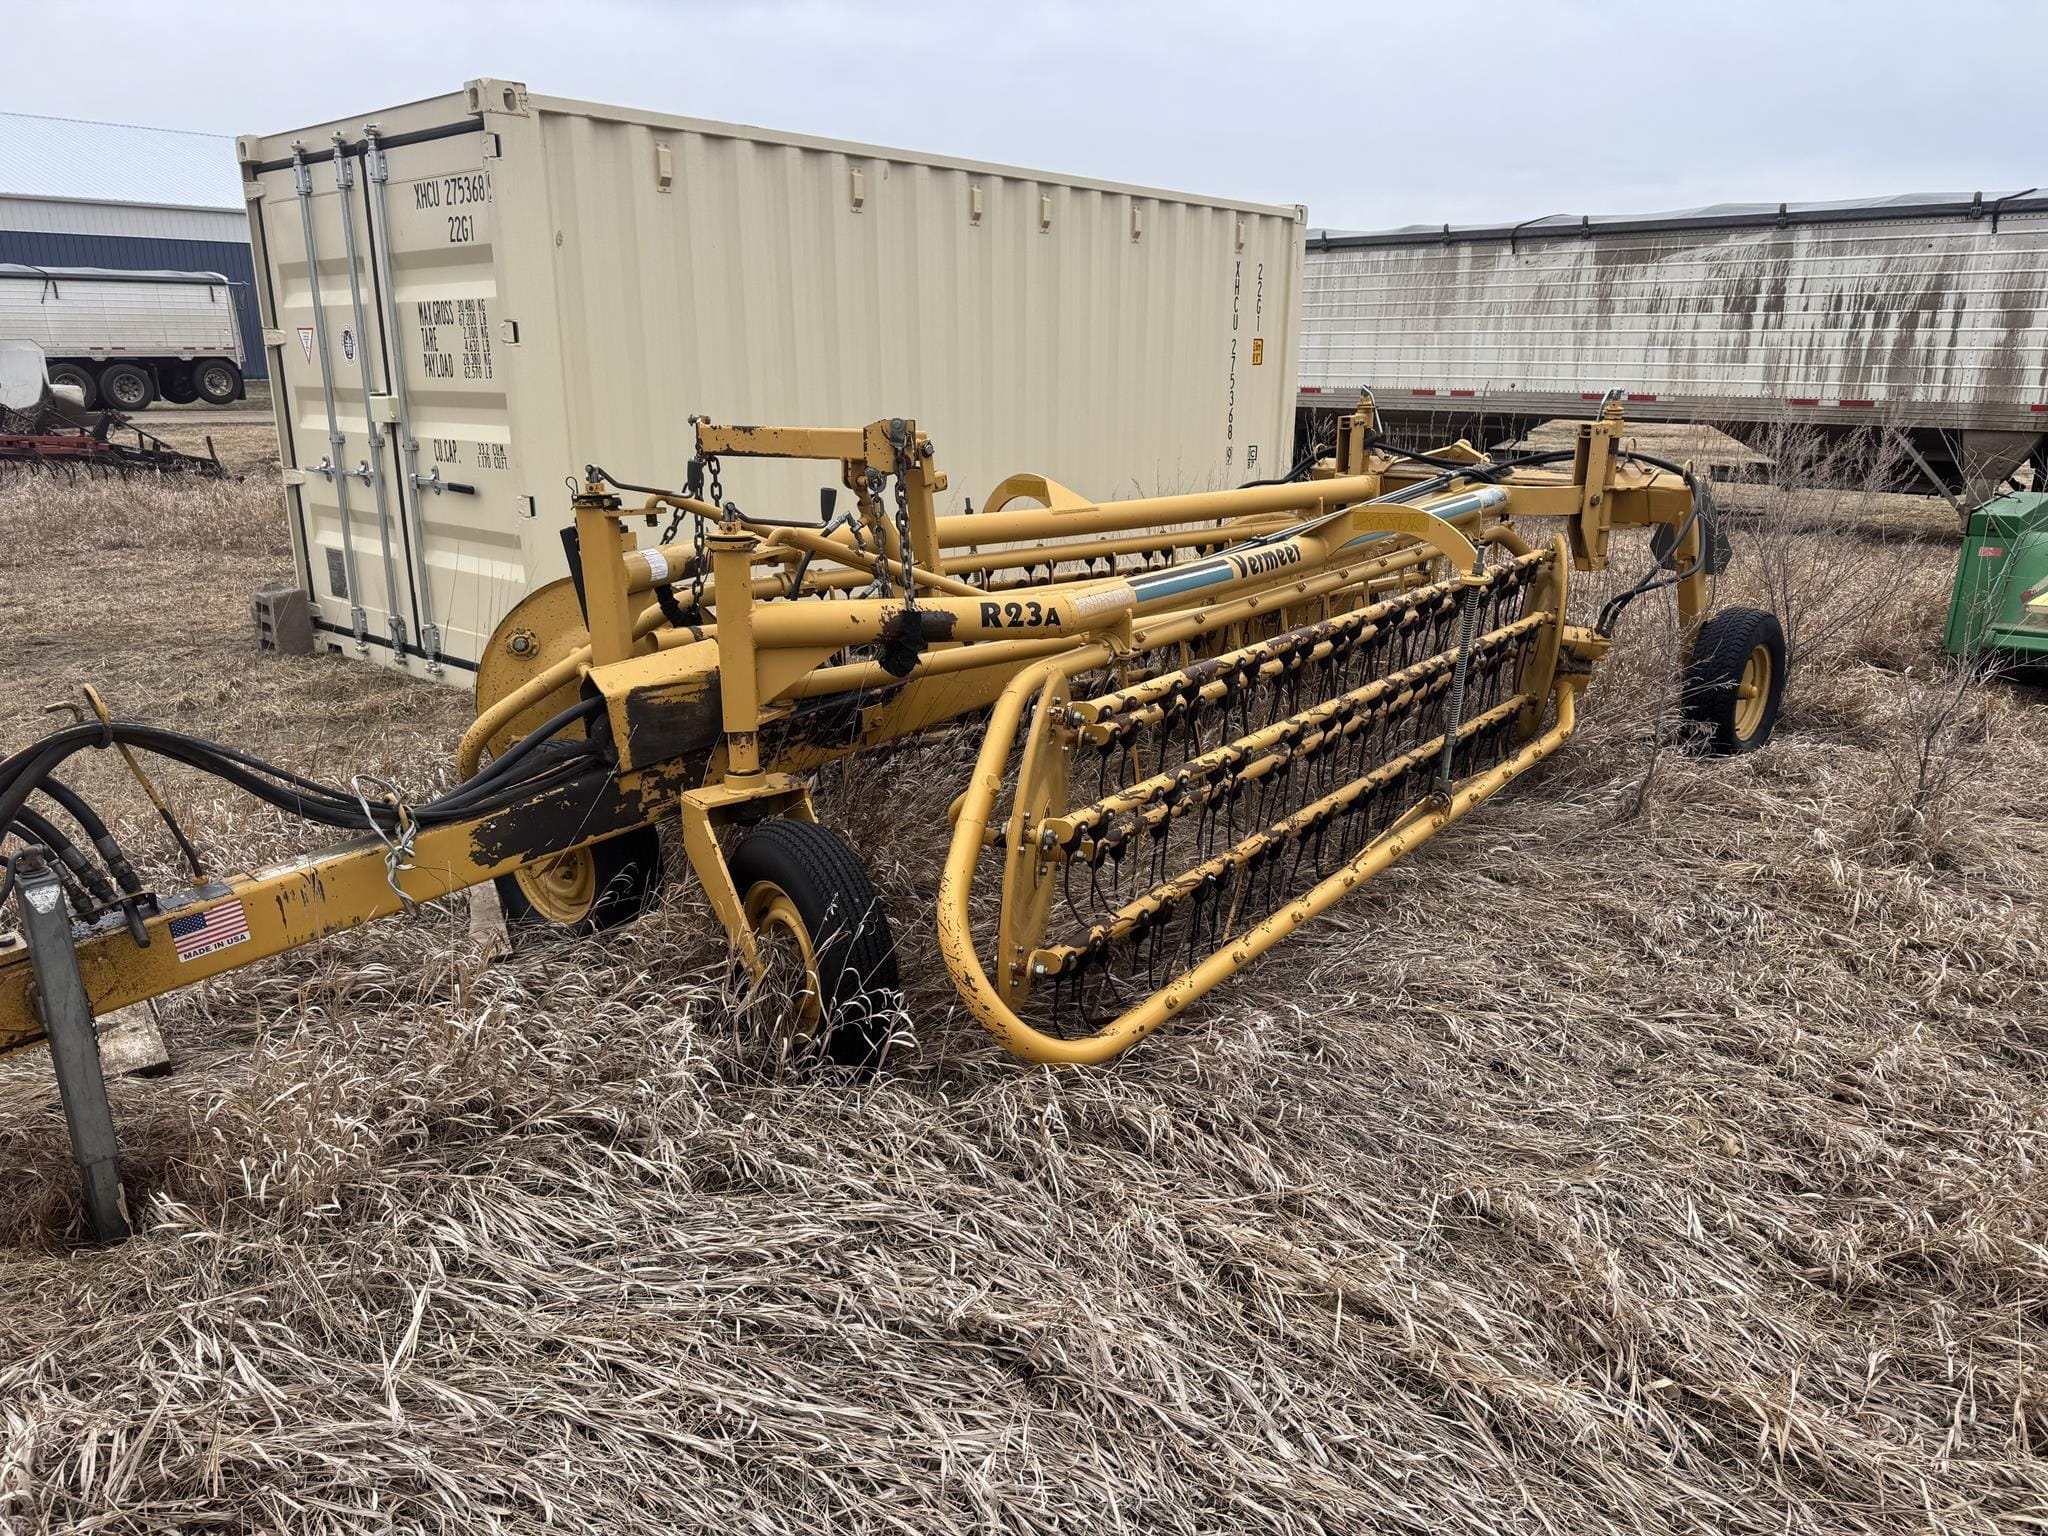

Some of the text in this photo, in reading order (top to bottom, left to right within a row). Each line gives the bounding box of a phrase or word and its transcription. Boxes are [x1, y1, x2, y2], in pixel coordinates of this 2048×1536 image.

[413, 180, 440, 210] XHCU
[444, 174, 485, 206] 275368
[448, 215, 475, 243] 22G1
[1232, 260, 1241, 331] XHCU
[1256, 263, 1264, 332] 22G1
[417, 300, 433, 327] MAX
[433, 299, 455, 326] GROSS
[478, 298, 486, 312] KG
[479, 312, 487, 326] LB
[421, 327, 439, 352] TARE
[481, 325, 489, 339] KG
[482, 339, 491, 352] LB
[423, 353, 454, 378] PAYLOAD
[484, 352, 492, 366] KG
[485, 365, 493, 379] LB
[1227, 338, 1237, 440] 275368
[1227, 543, 1302, 579] Vermeer
[979, 601, 1062, 629] R23A
[183, 934, 247, 961] MADE IN USA
